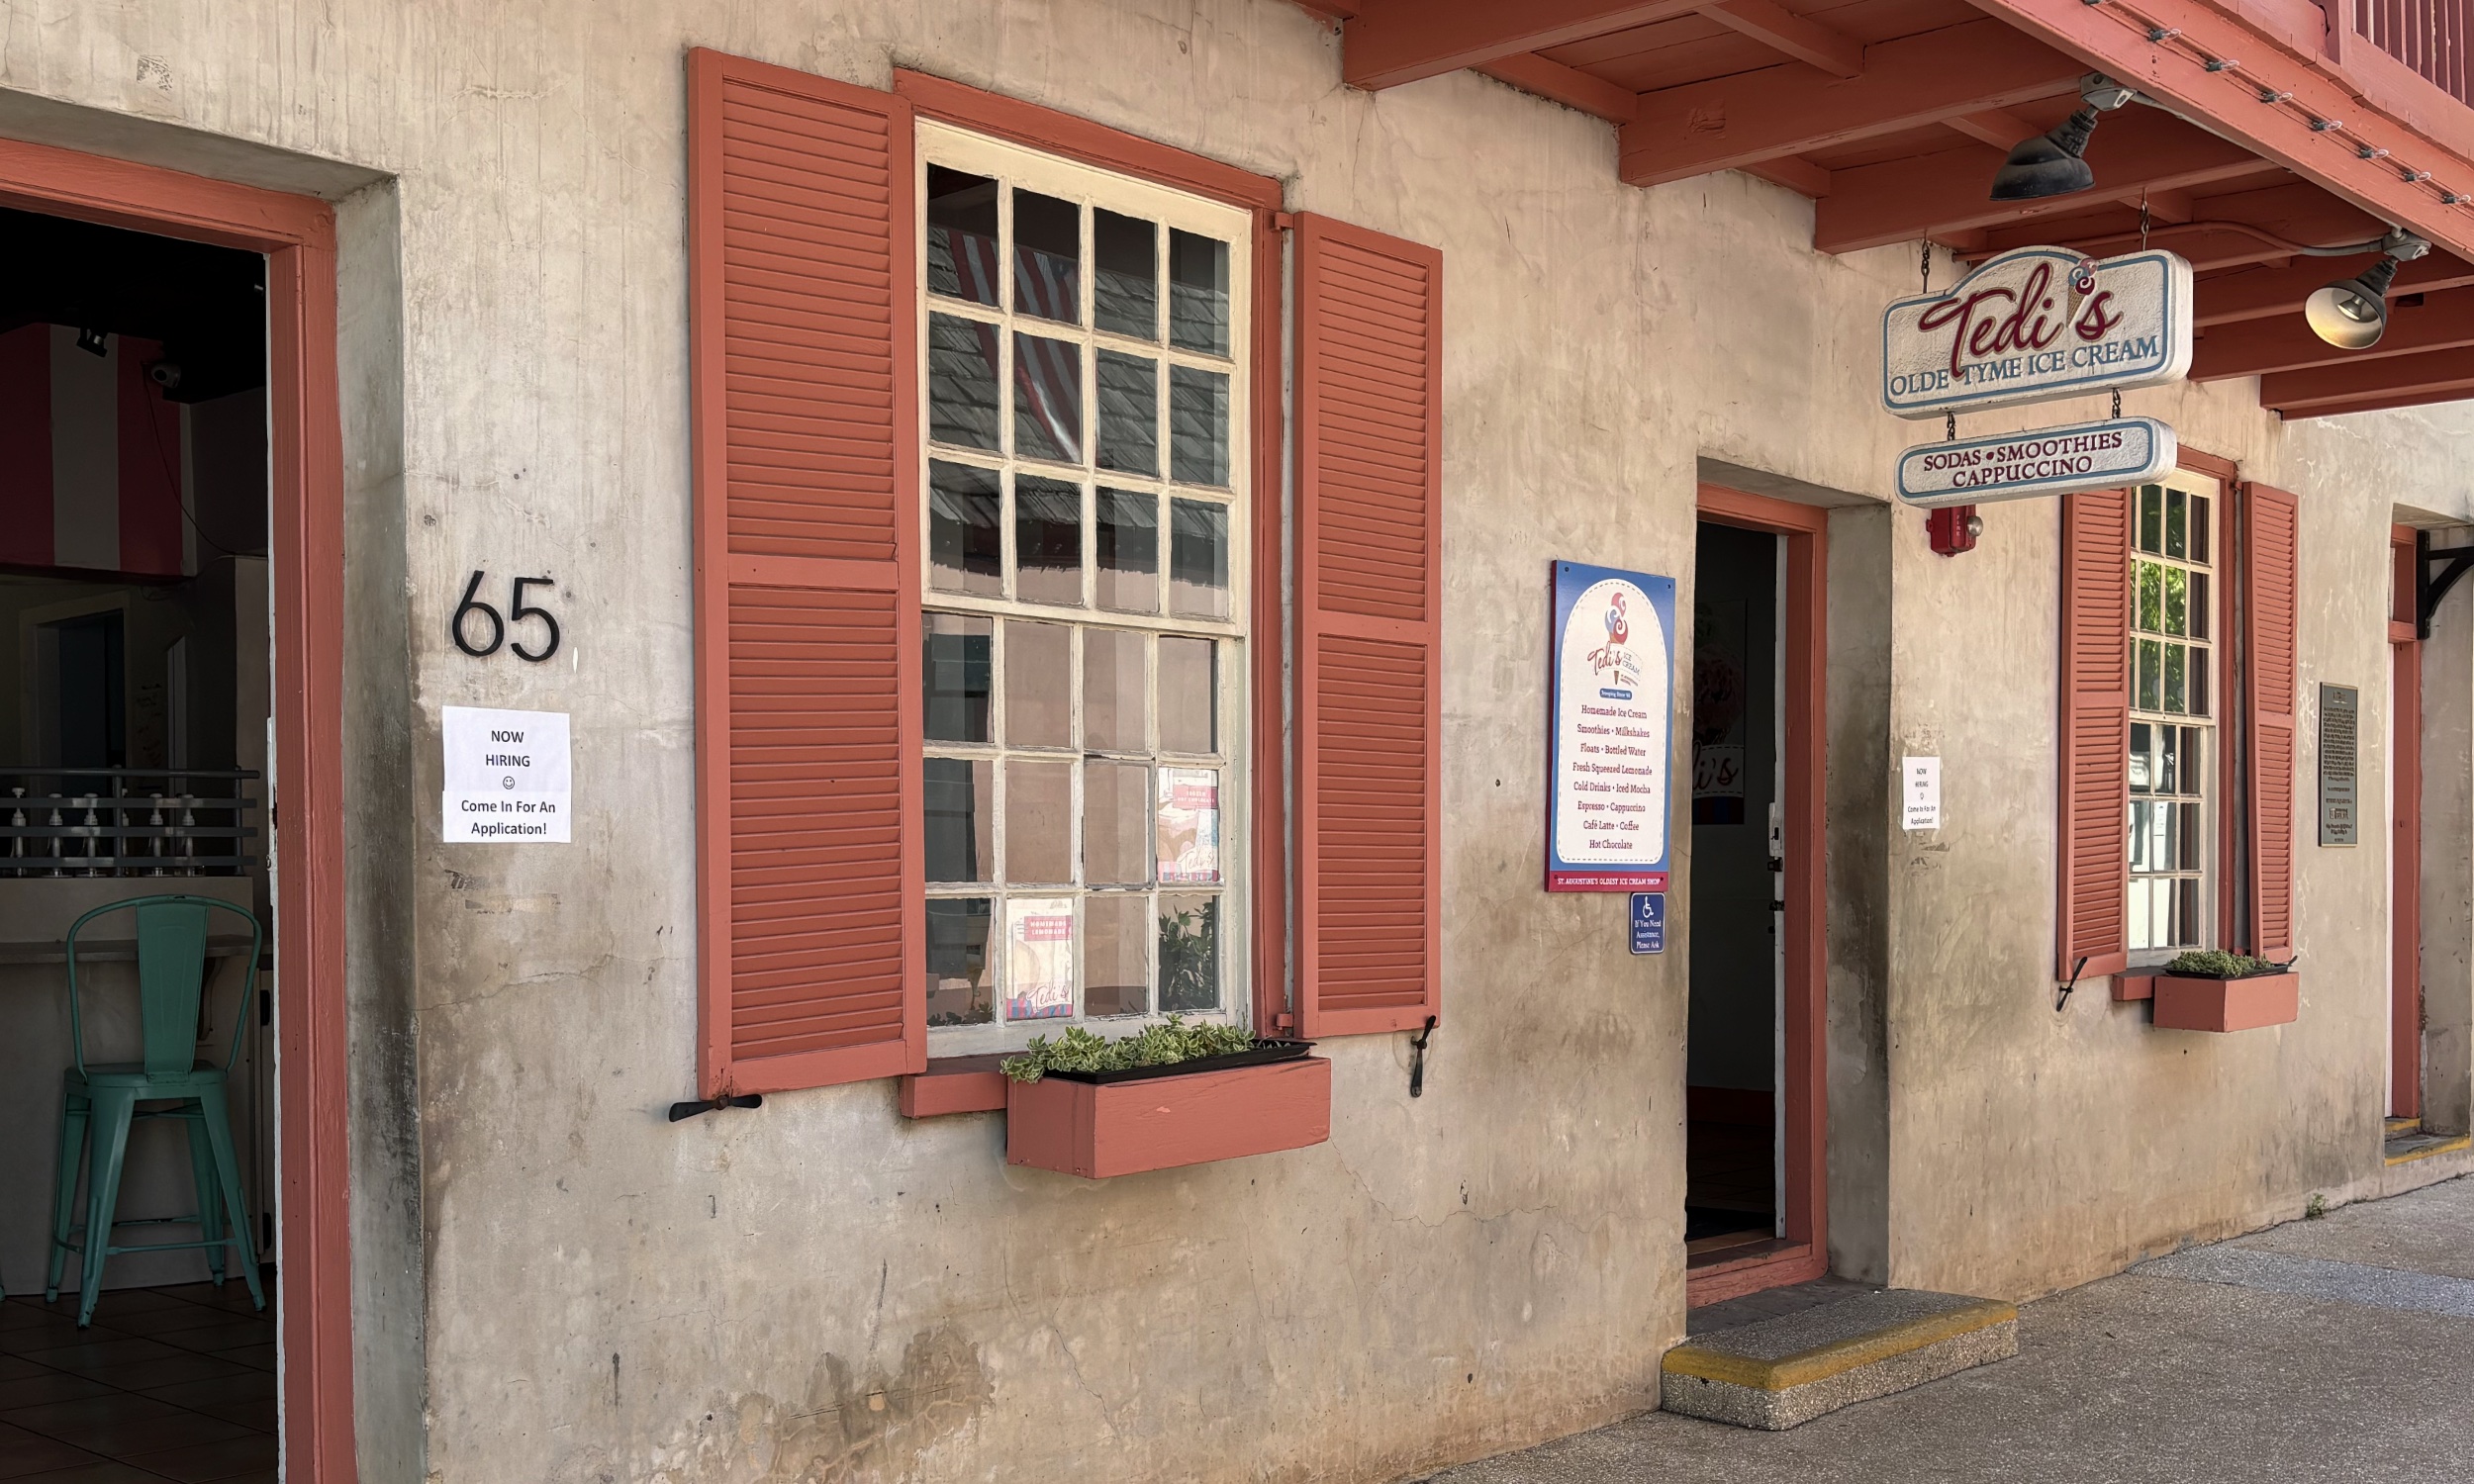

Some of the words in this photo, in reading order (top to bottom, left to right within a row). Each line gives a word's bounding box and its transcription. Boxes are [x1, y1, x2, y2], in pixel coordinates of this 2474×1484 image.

[1919, 262, 2124, 380] Tedi's
[1889, 370, 1951, 397] OLDE
[1960, 357, 2022, 387] TYME
[2028, 351, 2066, 376] ICE
[2071, 335, 2159, 368] CREAM
[1923, 449, 1982, 473] SODAS
[1996, 431, 2123, 463] SMOOTHIES
[1952, 456, 2093, 488] CAPPUCCINO
[451, 570, 561, 662] 65
[1580, 704, 1617, 716] Homemade
[1618, 707, 1627, 717] Ice
[1628, 709, 1648, 719] Cream
[491, 729, 524, 744] NOW
[1576, 723, 1611, 735] Smoothies
[1615, 726, 1651, 738] Milkshakes
[1580, 742, 1600, 754] Floats
[1604, 744, 1628, 756] Bottled
[1628, 746, 1647, 757] Water
[485, 754, 531, 768] HIRING
[1572, 761, 1591, 773] Fresh
[1591, 763, 1621, 775] Squeezed
[1621, 765, 1653, 776] Lemonade
[1573, 780, 1588, 791] Cold
[1589, 782, 1611, 792] Drinks
[1616, 782, 1629, 793] Iced
[1630, 784, 1651, 794] Mocha
[461, 799, 498, 814] Come
[501, 800, 513, 813] In
[516, 800, 536, 814] For
[539, 799, 556, 814] An
[1577, 800, 1605, 813] Espresso
[1610, 801, 1646, 814] Cappuccino
[471, 815, 547, 838] Application!
[1583, 819, 1598, 830] Café
[1598, 820, 1615, 830] Latte
[1619, 819, 1640, 831] Coffee
[1589, 839, 1601, 849] Hot
[1602, 838, 1633, 850] Chocolate
[1635, 919, 1640, 928] If
[1640, 919, 1650, 928] You
[1650, 919, 1662, 928] Need
[1636, 941, 1651, 950] Please
[1651, 940, 1660, 949] Ask
